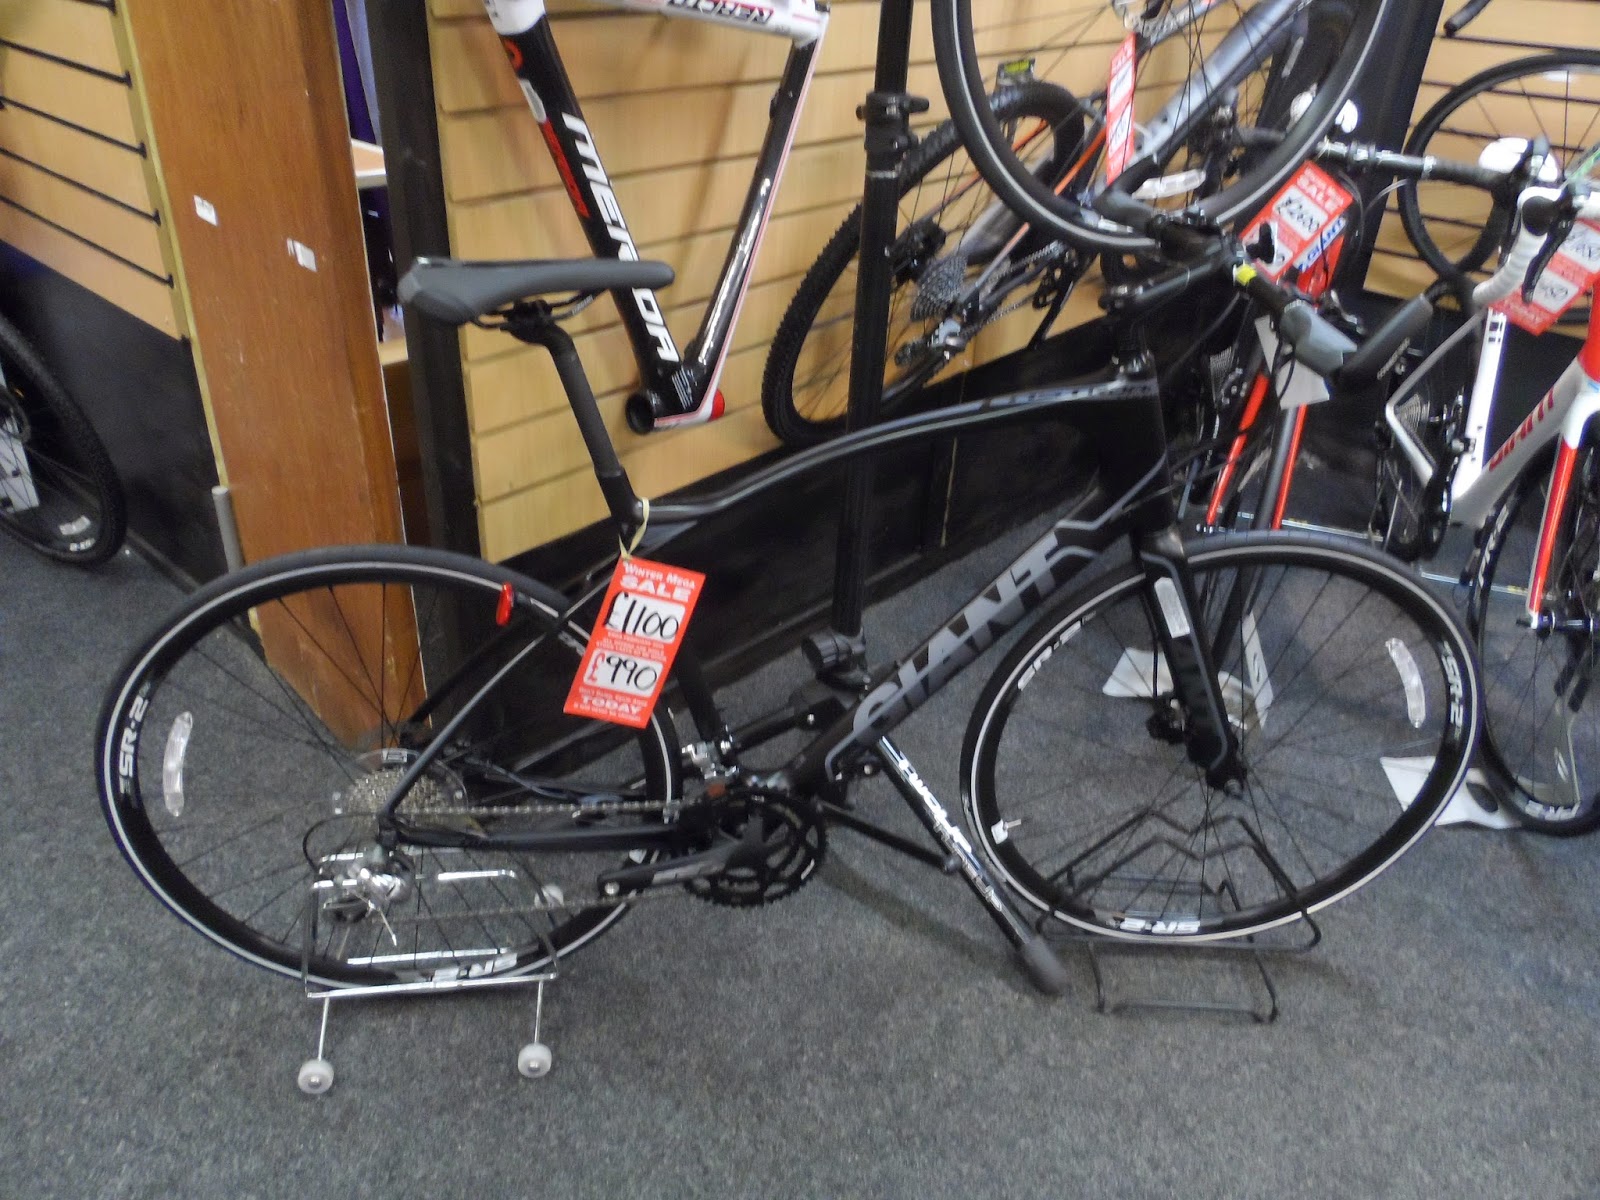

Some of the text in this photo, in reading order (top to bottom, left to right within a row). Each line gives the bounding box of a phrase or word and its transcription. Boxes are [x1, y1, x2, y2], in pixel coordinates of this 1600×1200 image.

[561, 111, 681, 362] MERDA
[619, 574, 692, 603] SALE
[623, 561, 696, 589] WINTER MEGA
[603, 591, 679, 640] £1100
[853, 530, 1060, 744] GIANT
[588, 652, 658, 692] £990
[581, 697, 643, 715] TODAY
[118, 694, 149, 777] SR-2
